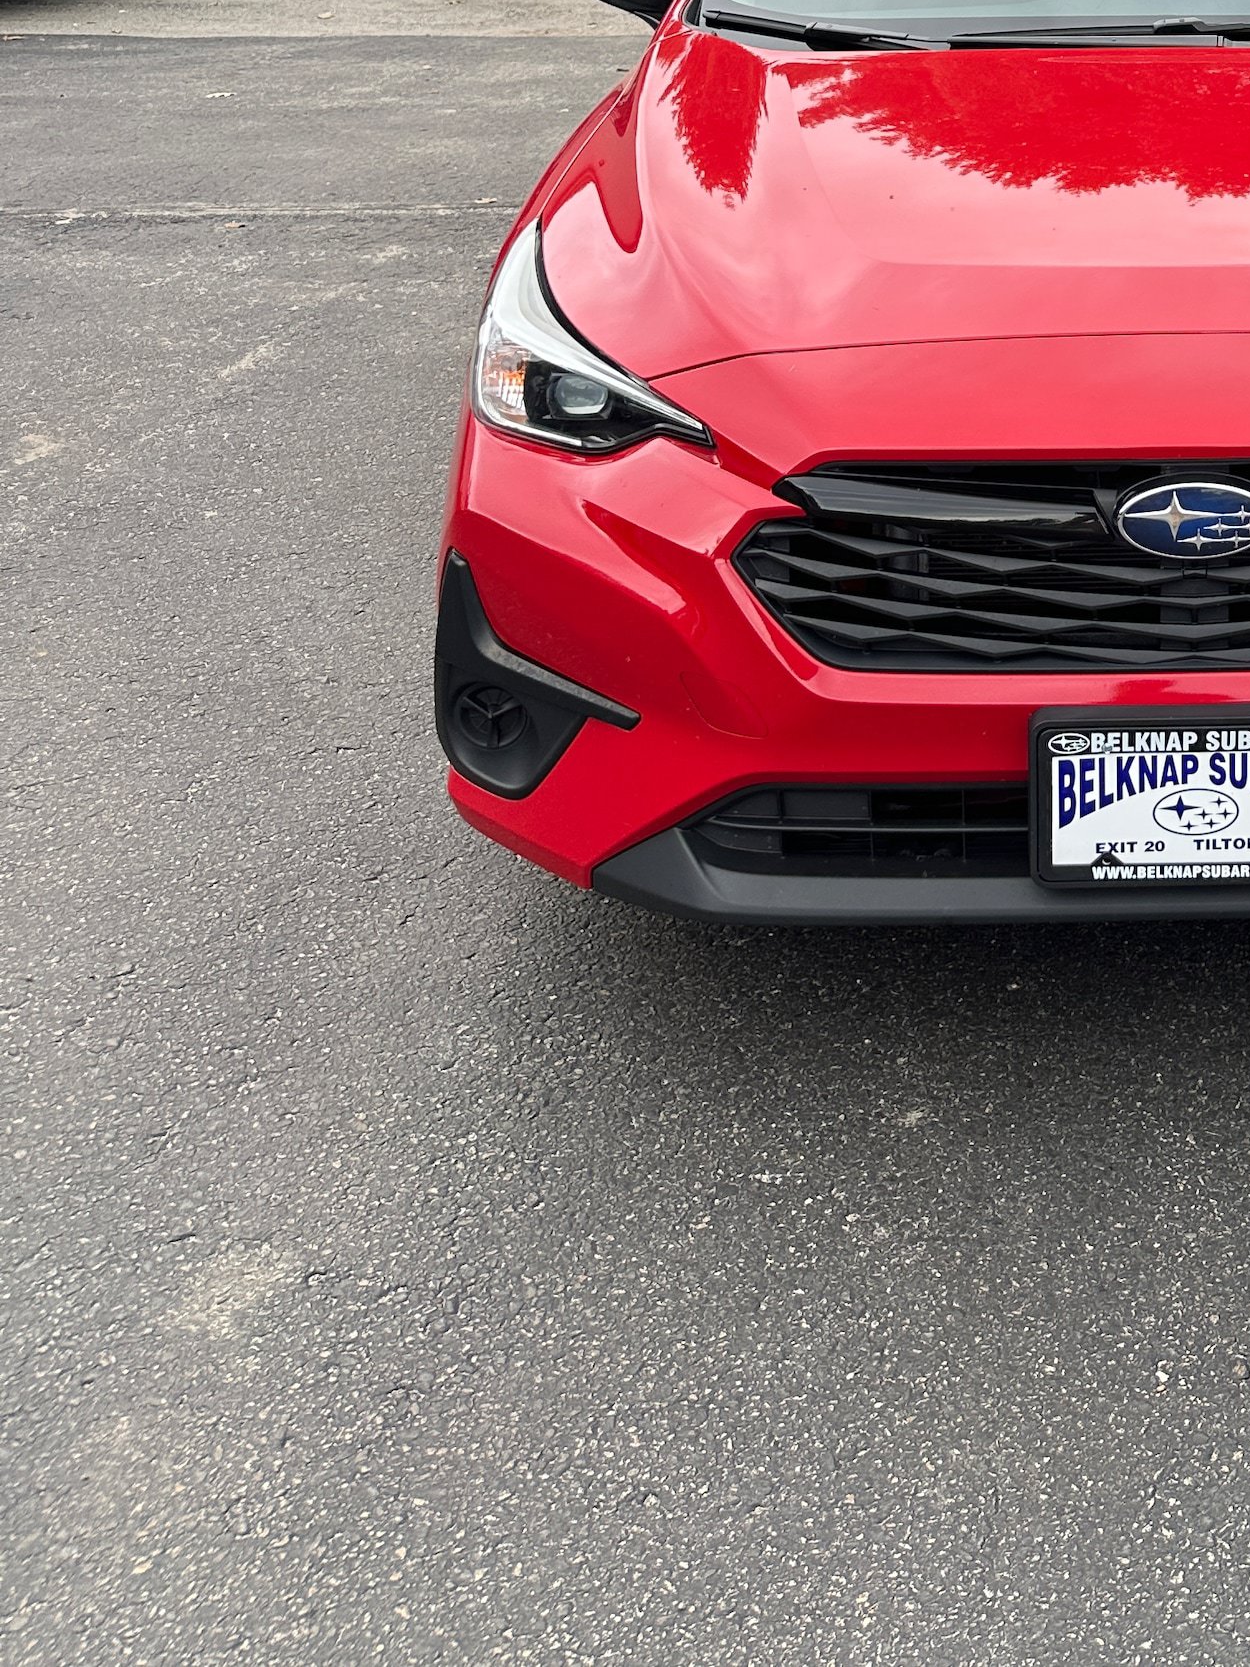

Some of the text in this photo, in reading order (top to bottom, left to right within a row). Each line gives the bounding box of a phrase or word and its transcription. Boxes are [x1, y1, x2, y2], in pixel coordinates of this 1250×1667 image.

[1091, 731, 1198, 753] BELKNAP
[1058, 754, 1199, 829] BELKNAP
[1095, 840, 1166, 854] EXIT 20
